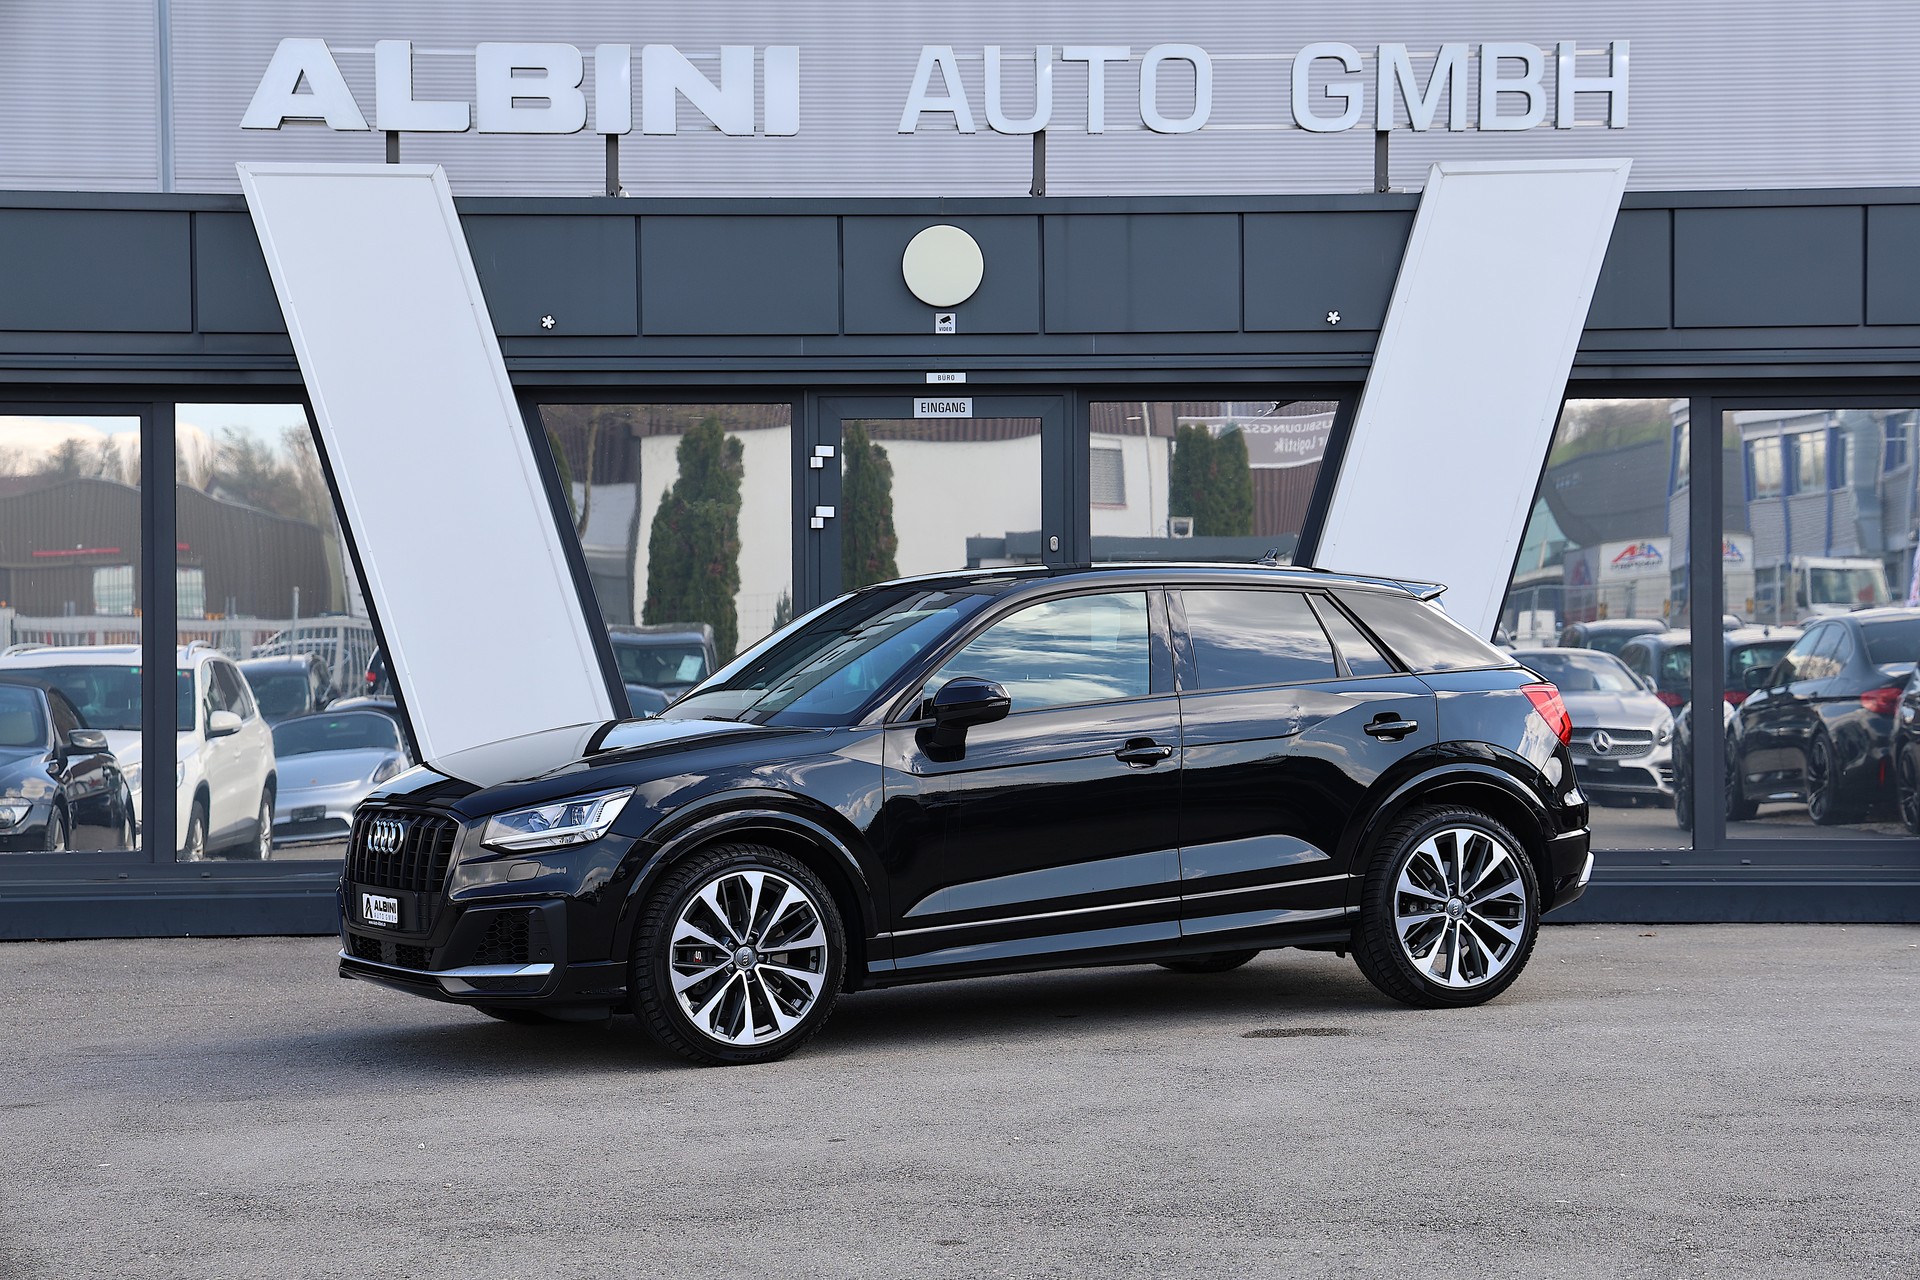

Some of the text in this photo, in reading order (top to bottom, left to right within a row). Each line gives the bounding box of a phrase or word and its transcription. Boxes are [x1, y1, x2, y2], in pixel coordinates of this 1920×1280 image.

[239, 37, 1630, 137] ALBINI AUTO GMBH
[920, 402, 966, 413] EINGANG
[374, 900, 396, 914] ALBINI
